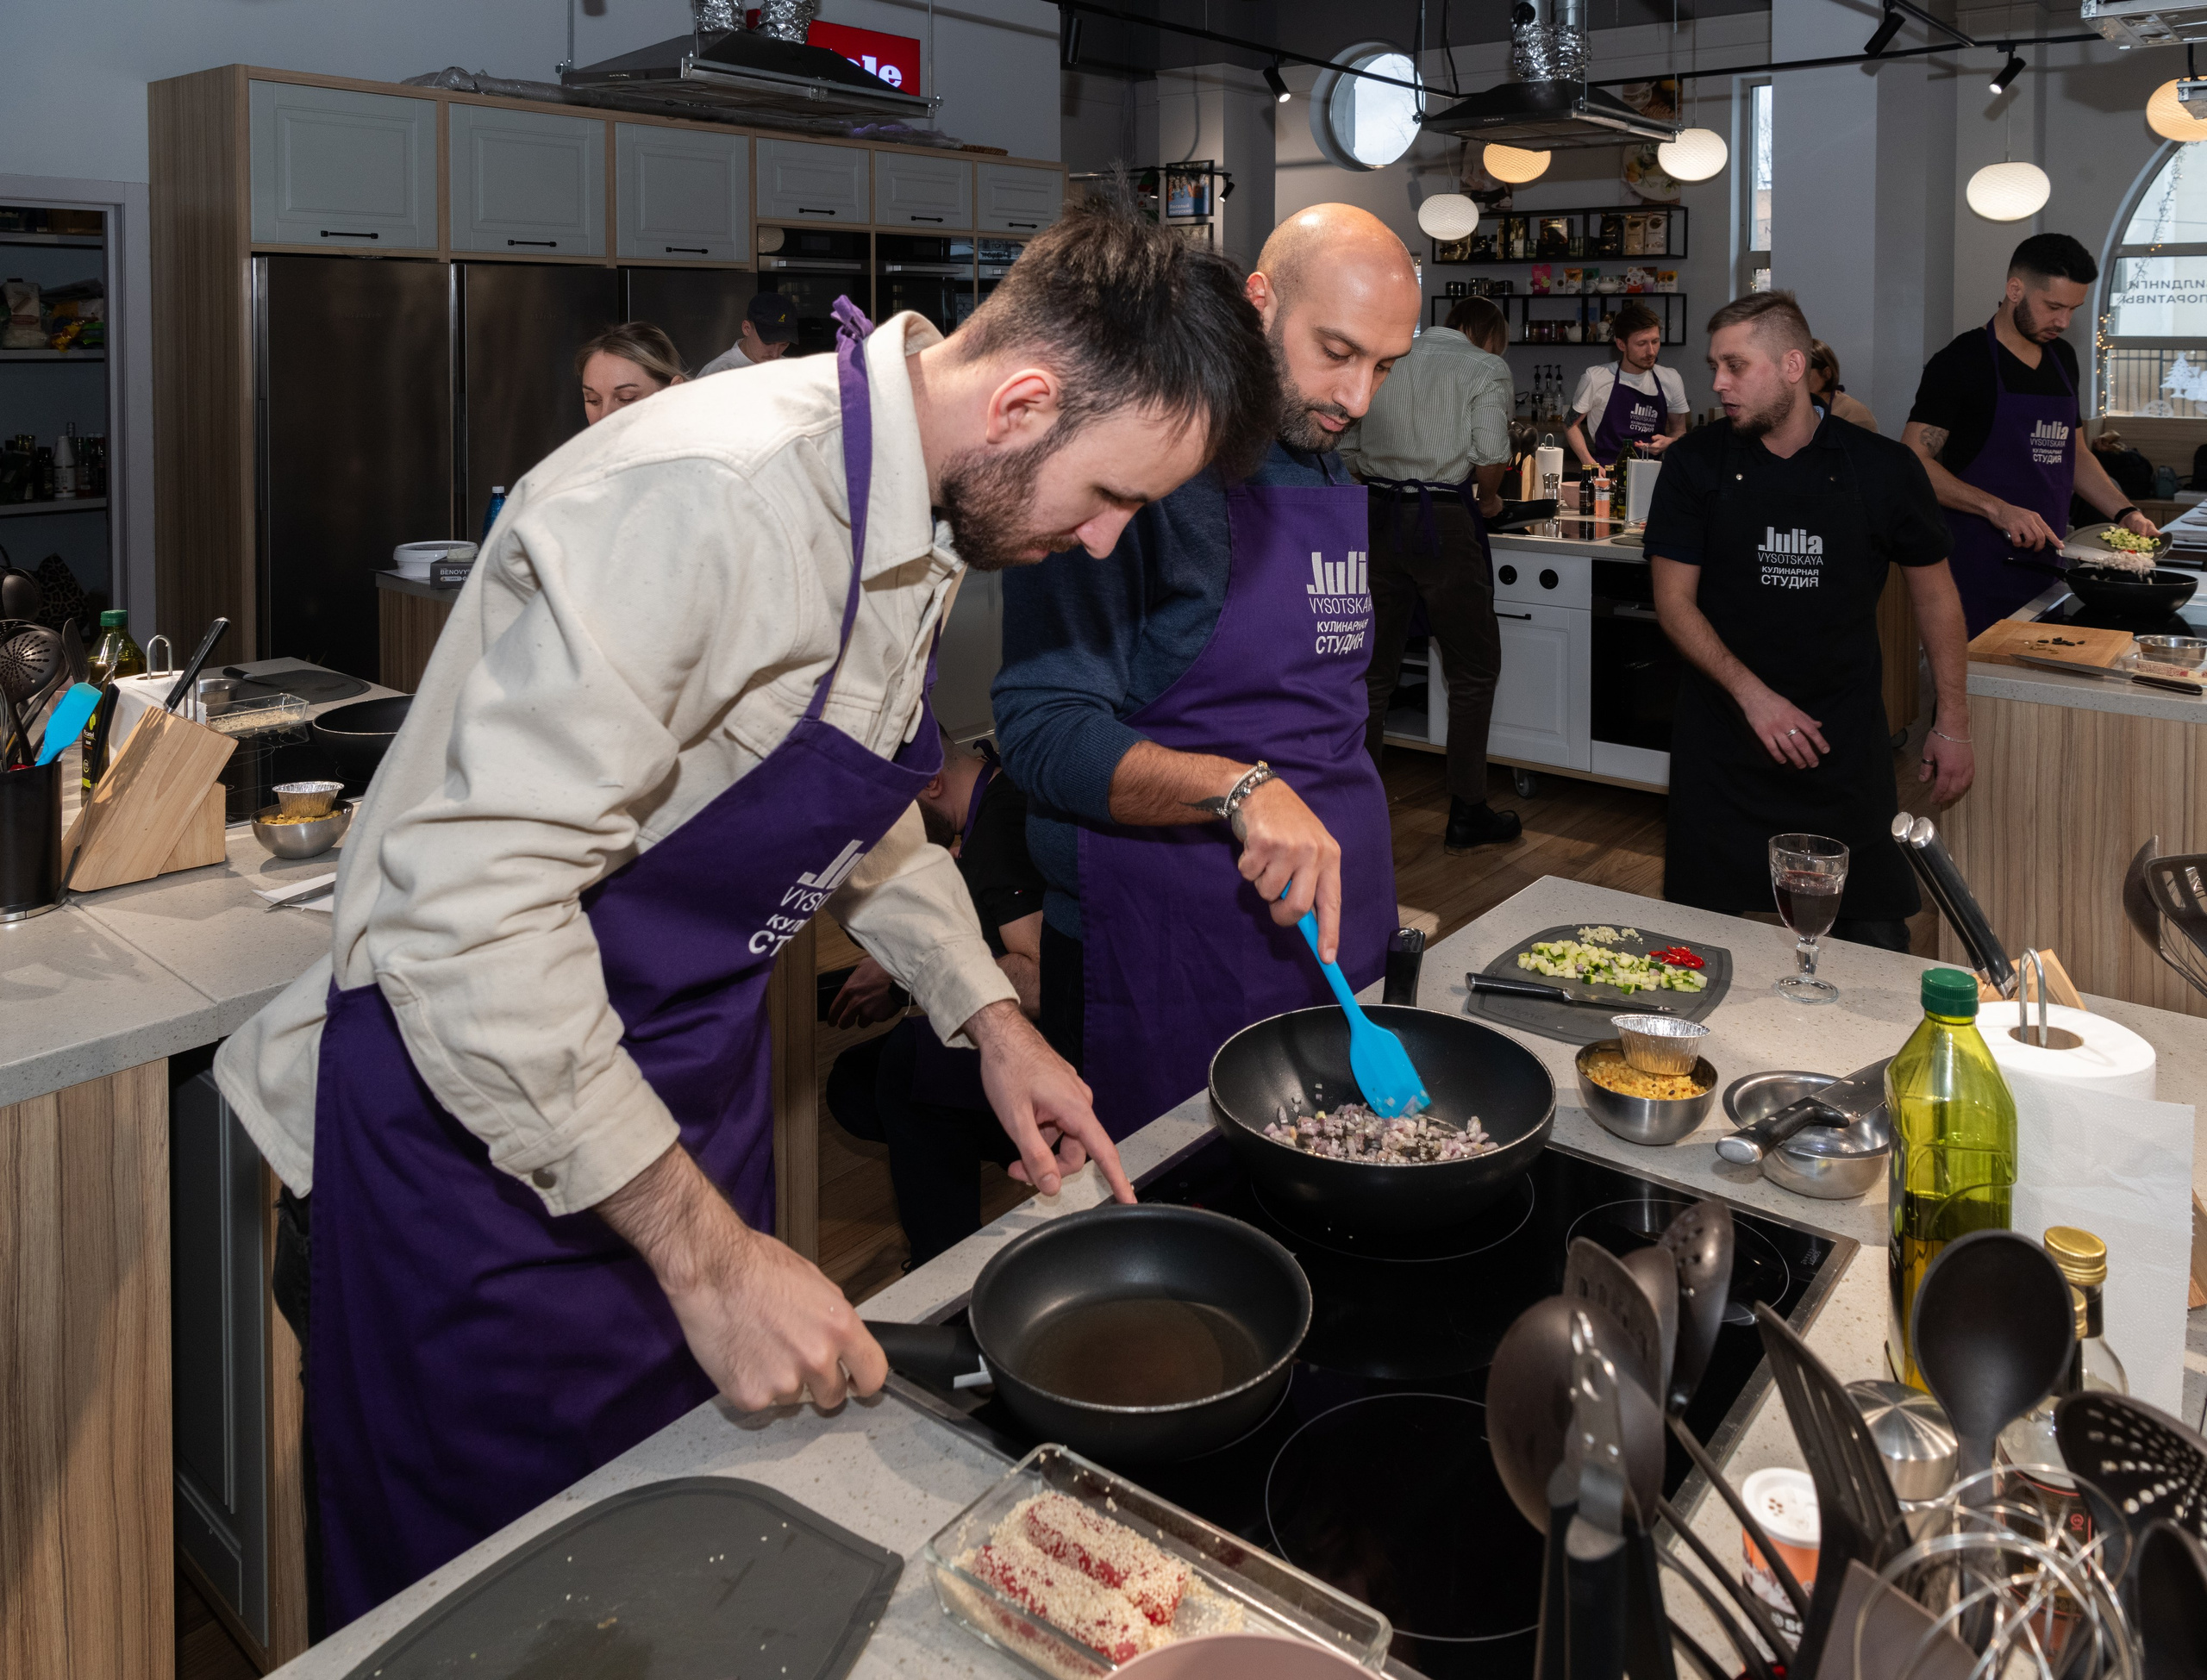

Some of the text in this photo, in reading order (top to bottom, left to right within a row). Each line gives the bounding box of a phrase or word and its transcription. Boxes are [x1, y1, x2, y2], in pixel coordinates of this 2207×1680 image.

[1630, 403, 1658, 418] Julia
[1629, 424, 1654, 433] СТУДИЯ
[2030, 419, 2069, 440] Julia
[2033, 453, 2062, 465] СТУДИЯ
[1757, 526, 1823, 554] Julia
[1757, 552, 1824, 565] VYSOTSKAYA
[1306, 551, 1371, 595] Juli
[1761, 565, 1819, 576] КУЛИНАРНАЯ
[1760, 574, 1819, 590] СТУДИЯ
[1315, 631, 1365, 655] СТУДИЯ
